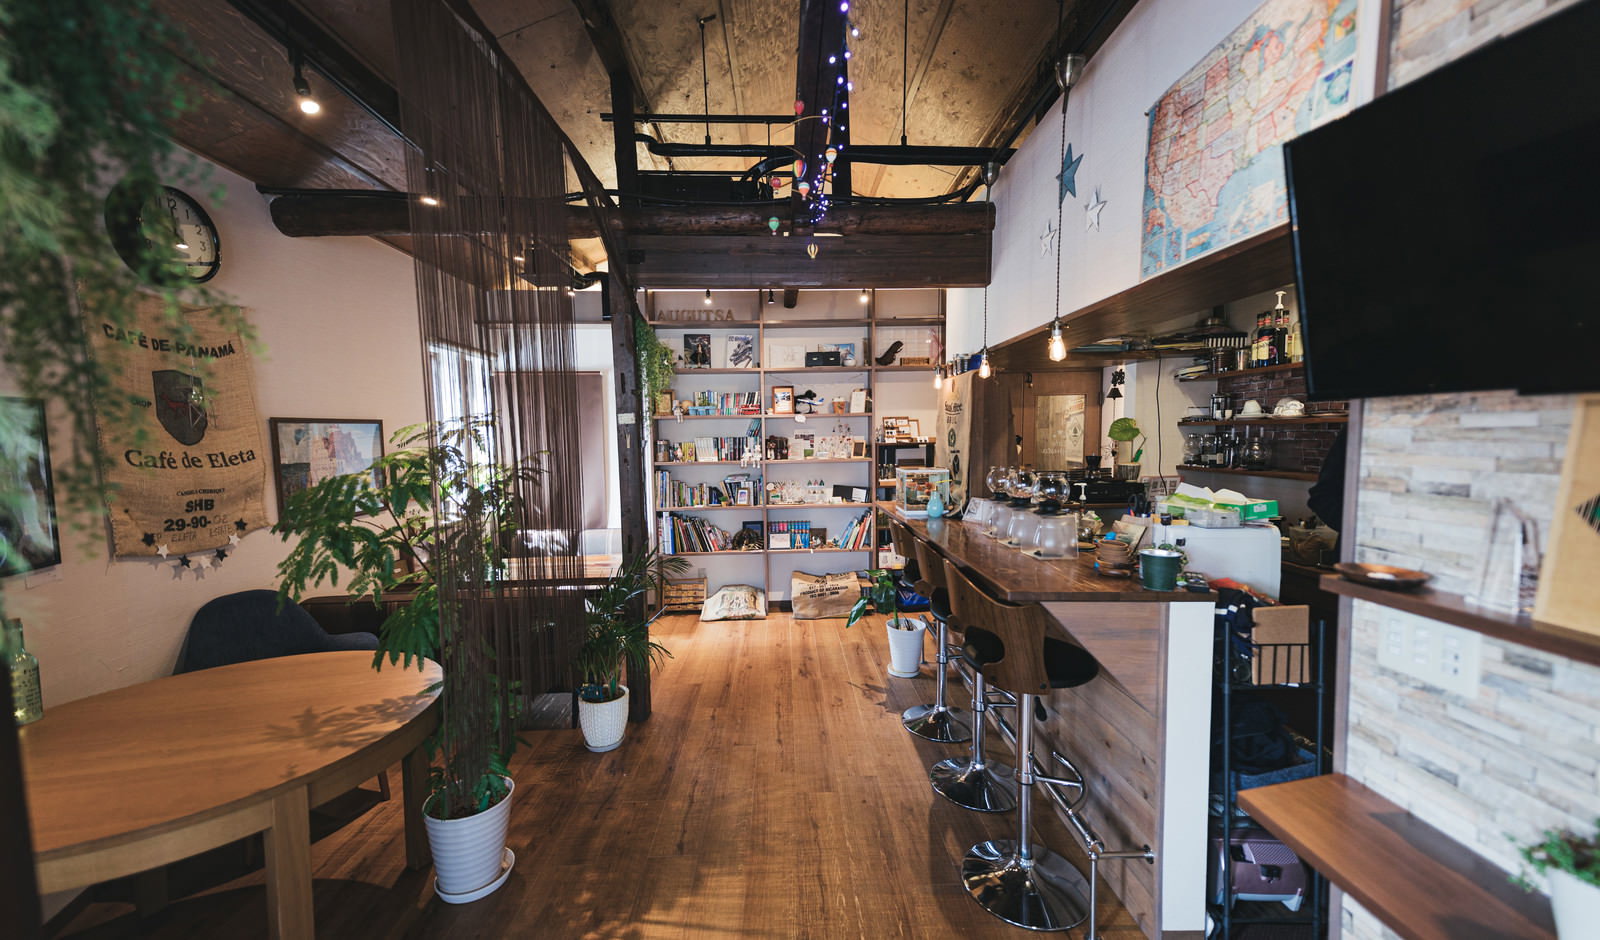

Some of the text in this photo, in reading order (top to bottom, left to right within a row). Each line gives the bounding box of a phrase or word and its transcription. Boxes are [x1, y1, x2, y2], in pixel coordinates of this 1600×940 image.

[167, 198, 177, 209] 12
[194, 225, 202, 236] 2
[199, 241, 207, 252] 3
[102, 323, 235, 358] CAFÉ DE PANAMÁ
[124, 449, 256, 469] Café de Eleta
[184, 499, 215, 513] SHB
